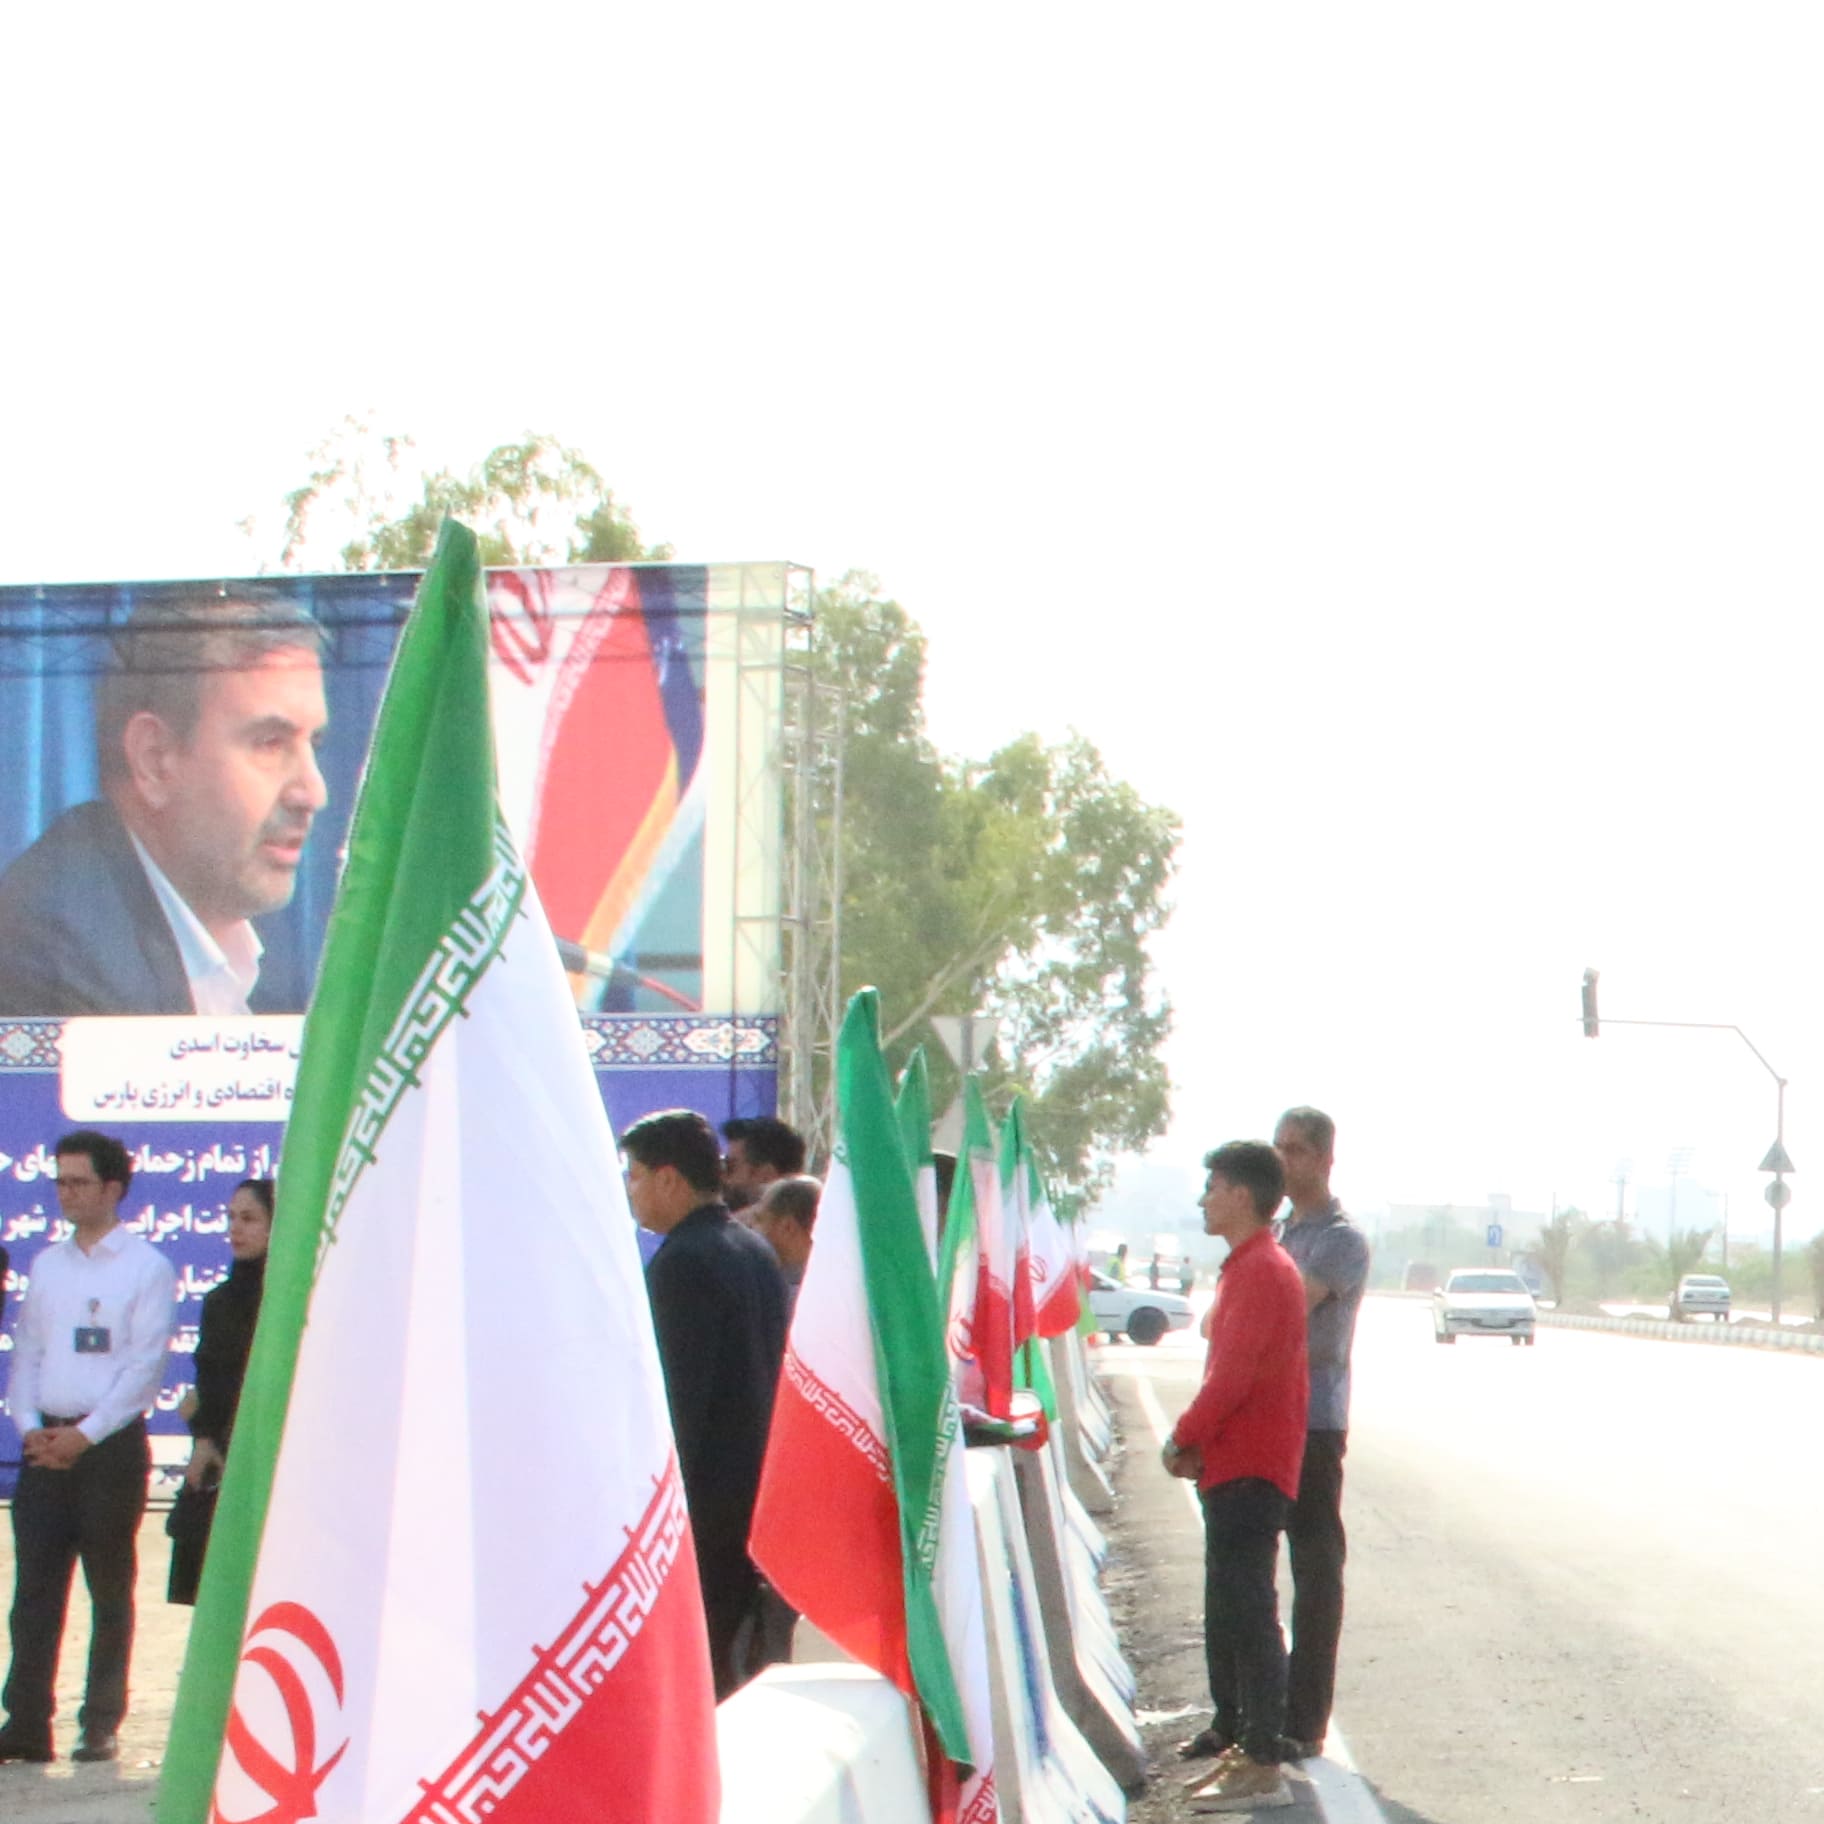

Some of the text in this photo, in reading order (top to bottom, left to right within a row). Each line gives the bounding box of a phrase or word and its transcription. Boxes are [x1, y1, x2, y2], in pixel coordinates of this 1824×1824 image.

[170, 1034, 219, 1059] اسدی
[223, 1033, 284, 1060] سخاوت
[94, 1081, 138, 1108] پارس
[193, 1090, 203, 1107] و
[207, 1079, 280, 1107] اقتصادی
[198, 1144, 246, 1181] تمام
[251, 1144, 269, 1179] از
